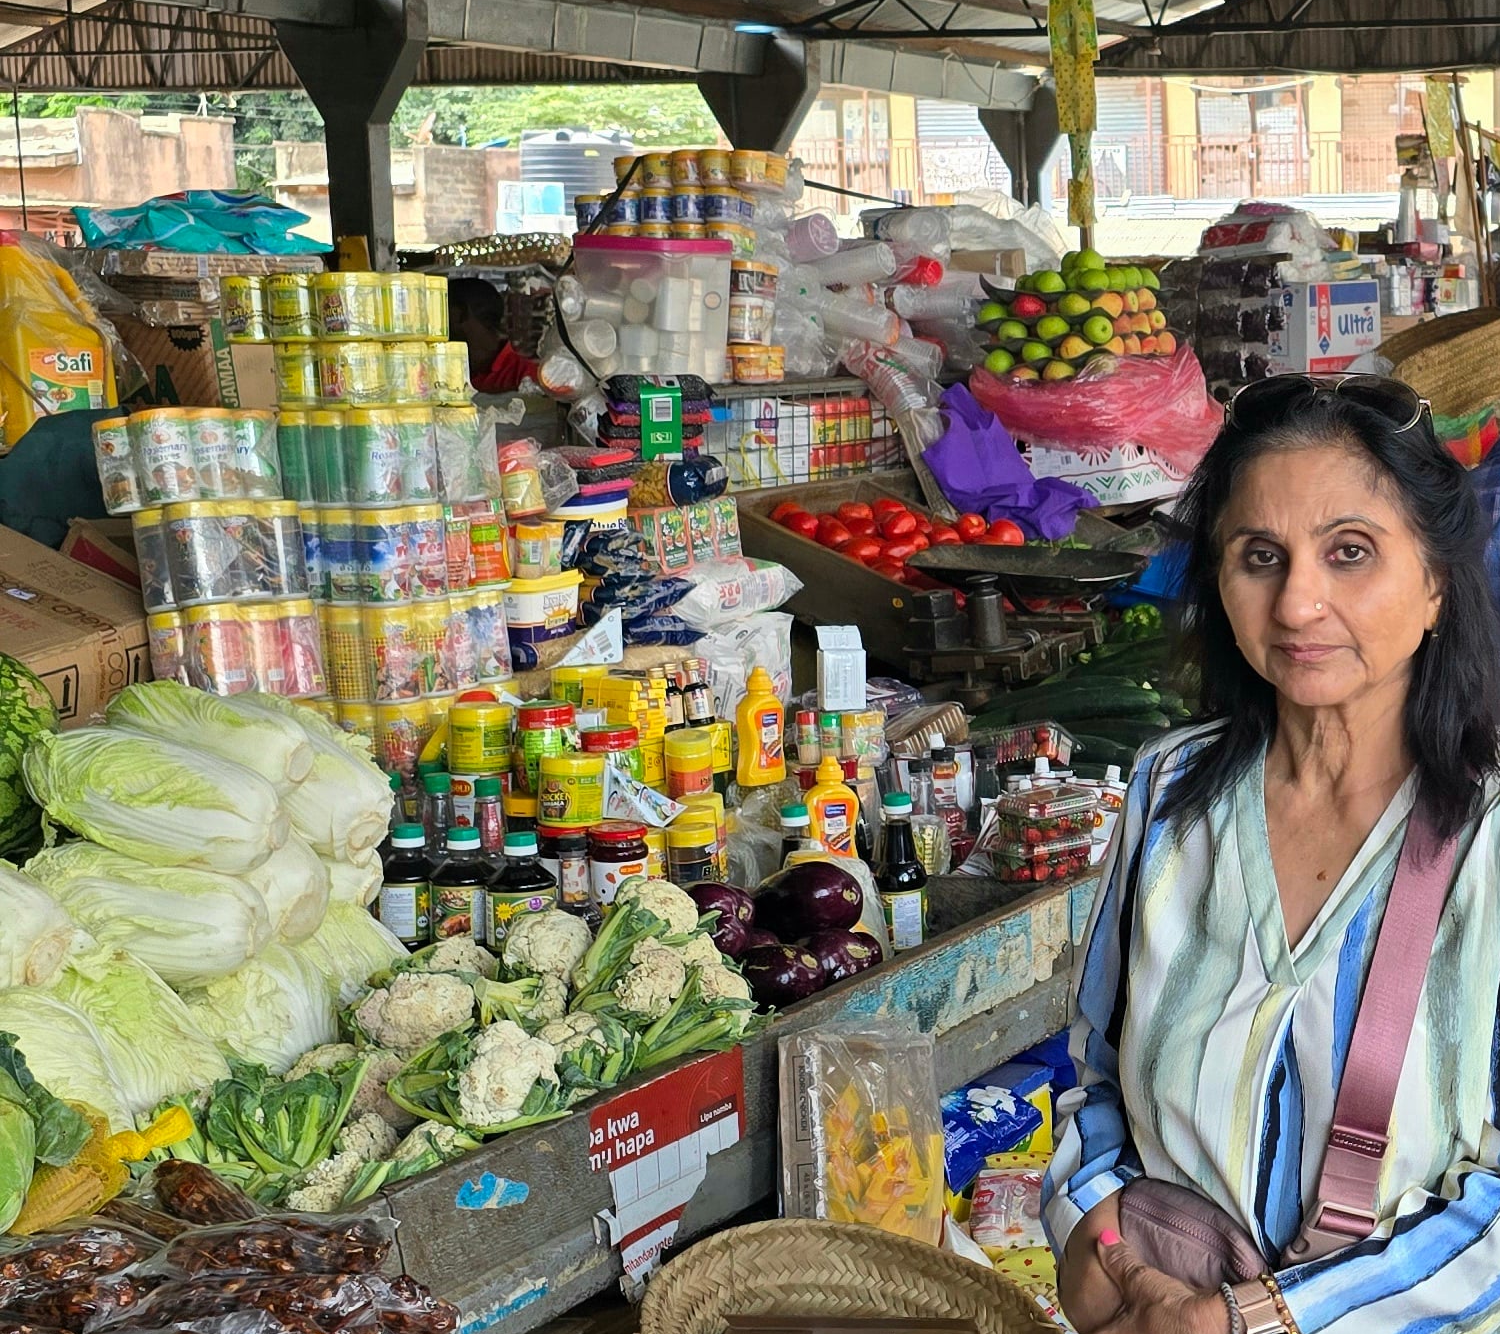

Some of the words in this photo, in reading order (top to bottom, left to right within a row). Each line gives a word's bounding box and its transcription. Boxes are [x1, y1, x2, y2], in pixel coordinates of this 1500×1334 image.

[1337, 313, 1374, 336] Ultra
[56, 352, 92, 373] Safi
[216, 347, 238, 408] JAMAA
[607, 1109, 640, 1138] kwa
[615, 1128, 655, 1163] hapa
